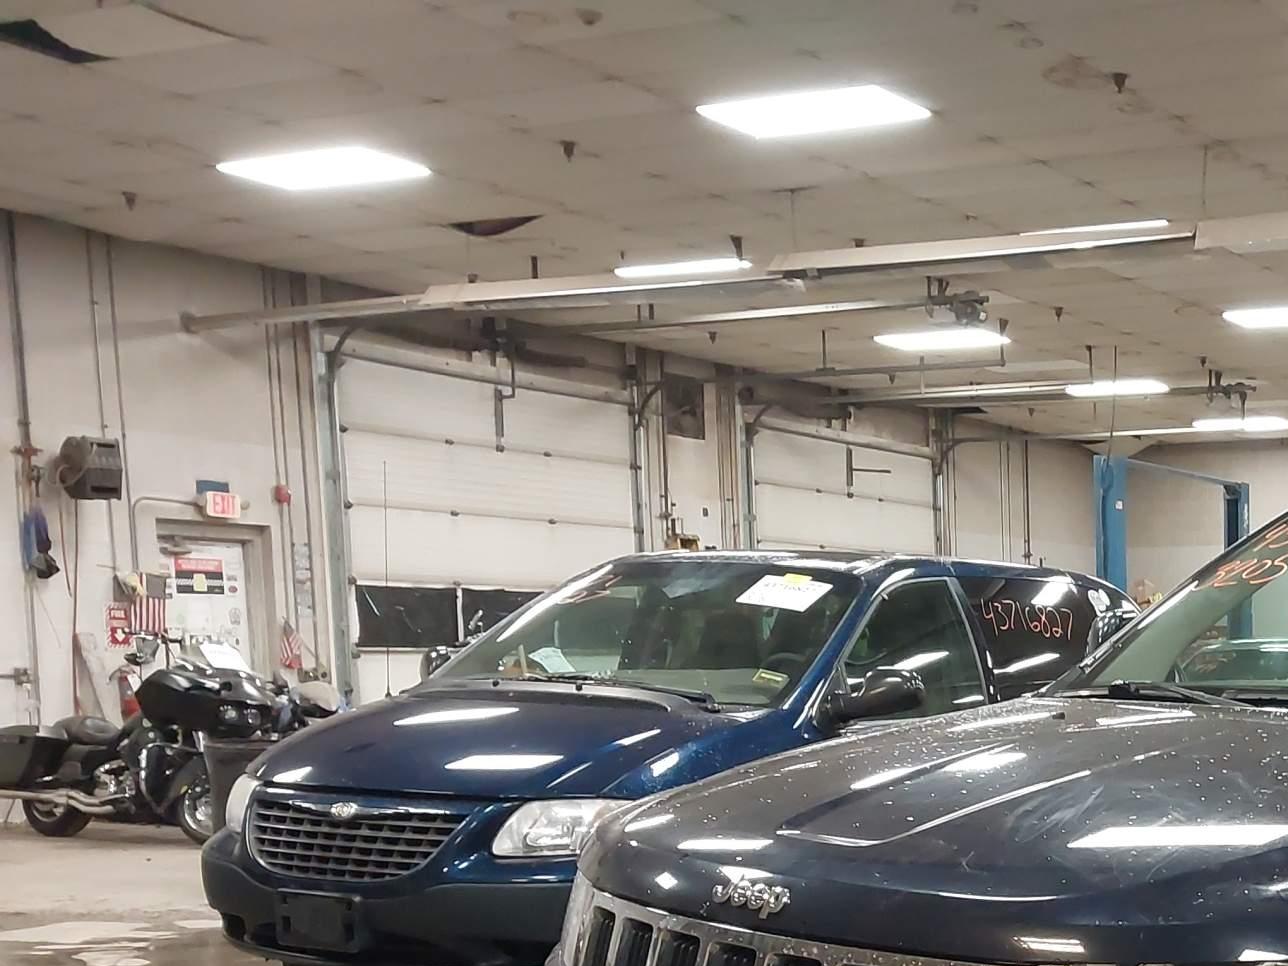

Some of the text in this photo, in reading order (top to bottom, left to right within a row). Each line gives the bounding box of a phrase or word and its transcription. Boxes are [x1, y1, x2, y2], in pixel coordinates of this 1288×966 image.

[212, 493, 237, 515] EXIT
[980, 597, 1074, 642] 43716827
[711, 875, 791, 920] Jeep
